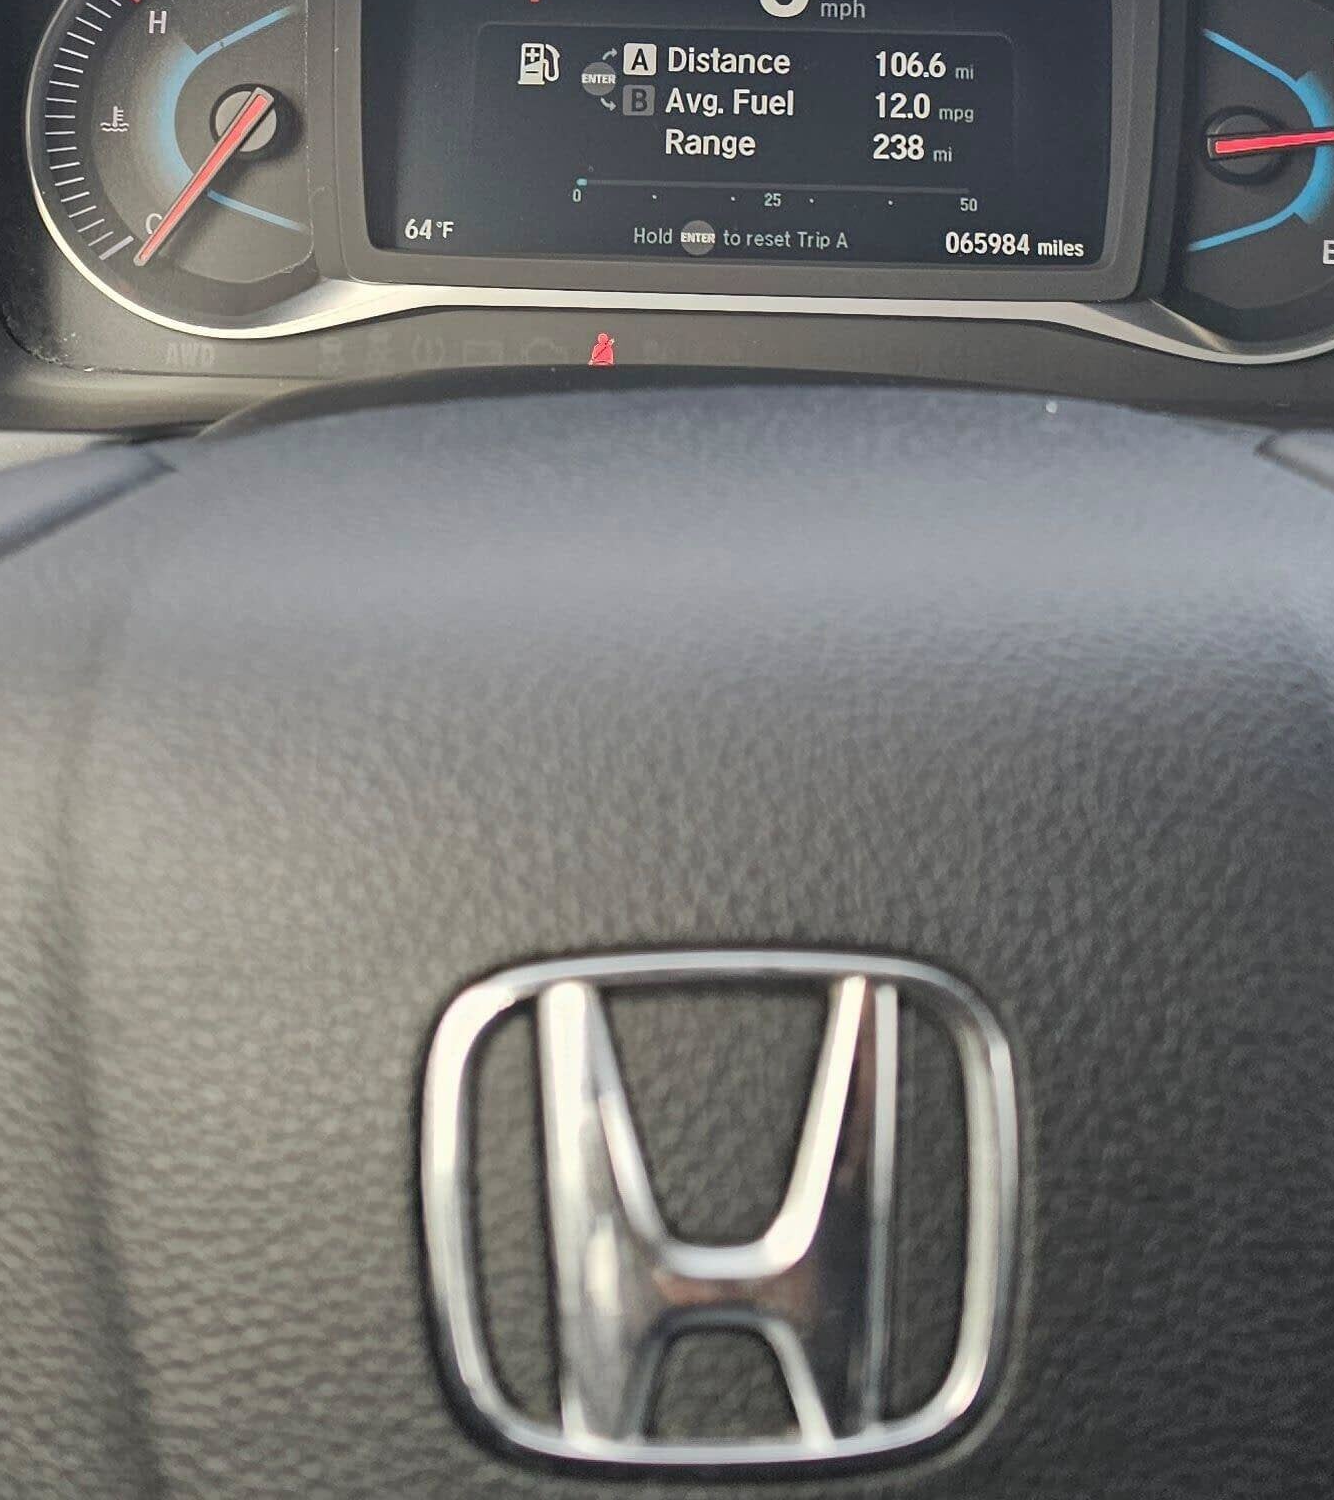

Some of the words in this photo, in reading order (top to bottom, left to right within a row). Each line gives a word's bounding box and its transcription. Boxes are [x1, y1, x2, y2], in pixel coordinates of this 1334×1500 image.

[148, 10, 167, 34] H
[630, 47, 649, 71] A
[668, 46, 791, 75] Distance
[875, 50, 947, 78] 106.6
[955, 67, 974, 80] mi
[581, 73, 616, 84] ENTER
[631, 88, 649, 115] B
[665, 87, 724, 118] Avg.
[733, 88, 794, 116] Fuel
[875, 91, 931, 119] 12.0
[938, 108, 974, 123] mpg
[665, 128, 756, 160] Range
[873, 133, 925, 161] 238
[933, 146, 953, 162] mi
[572, 188, 582, 203] 0
[764, 192, 782, 207] 25
[960, 197, 978, 212] 50
[633, 227, 673, 245] Hold
[680, 231, 716, 244] ENTER
[722, 229, 741, 246] to
[746, 230, 791, 248] reset
[796, 231, 831, 250] Trip
[835, 232, 849, 249] A
[945, 231, 1031, 256] 065984
[1037, 239, 1084, 257] miles
